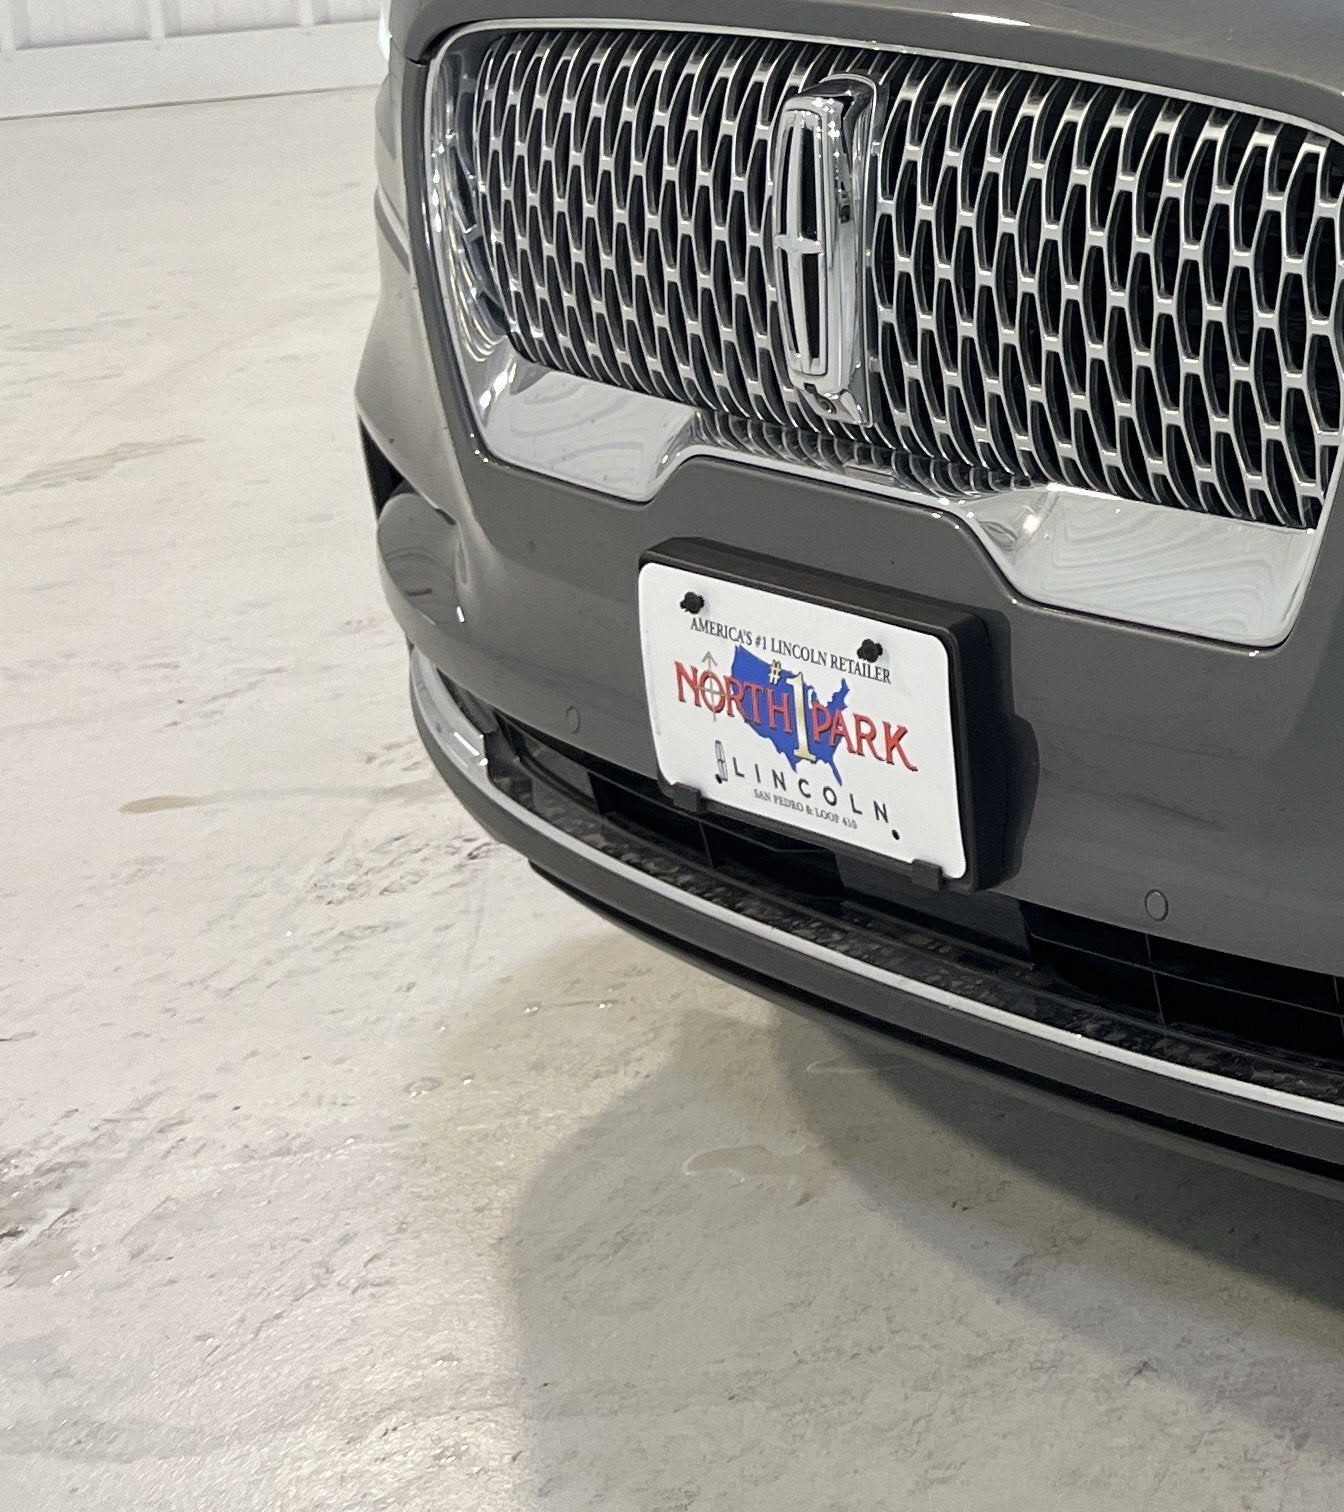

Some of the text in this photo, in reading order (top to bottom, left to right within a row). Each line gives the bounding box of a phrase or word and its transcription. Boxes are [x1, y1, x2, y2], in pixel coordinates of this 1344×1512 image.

[690, 617, 753, 646] AMERICA'S
[771, 637, 828, 667] LINCOLN
[830, 654, 892, 684] RETAILER
[674, 659, 919, 772] NORTH PARK
[732, 756, 889, 824] LINCOLN
